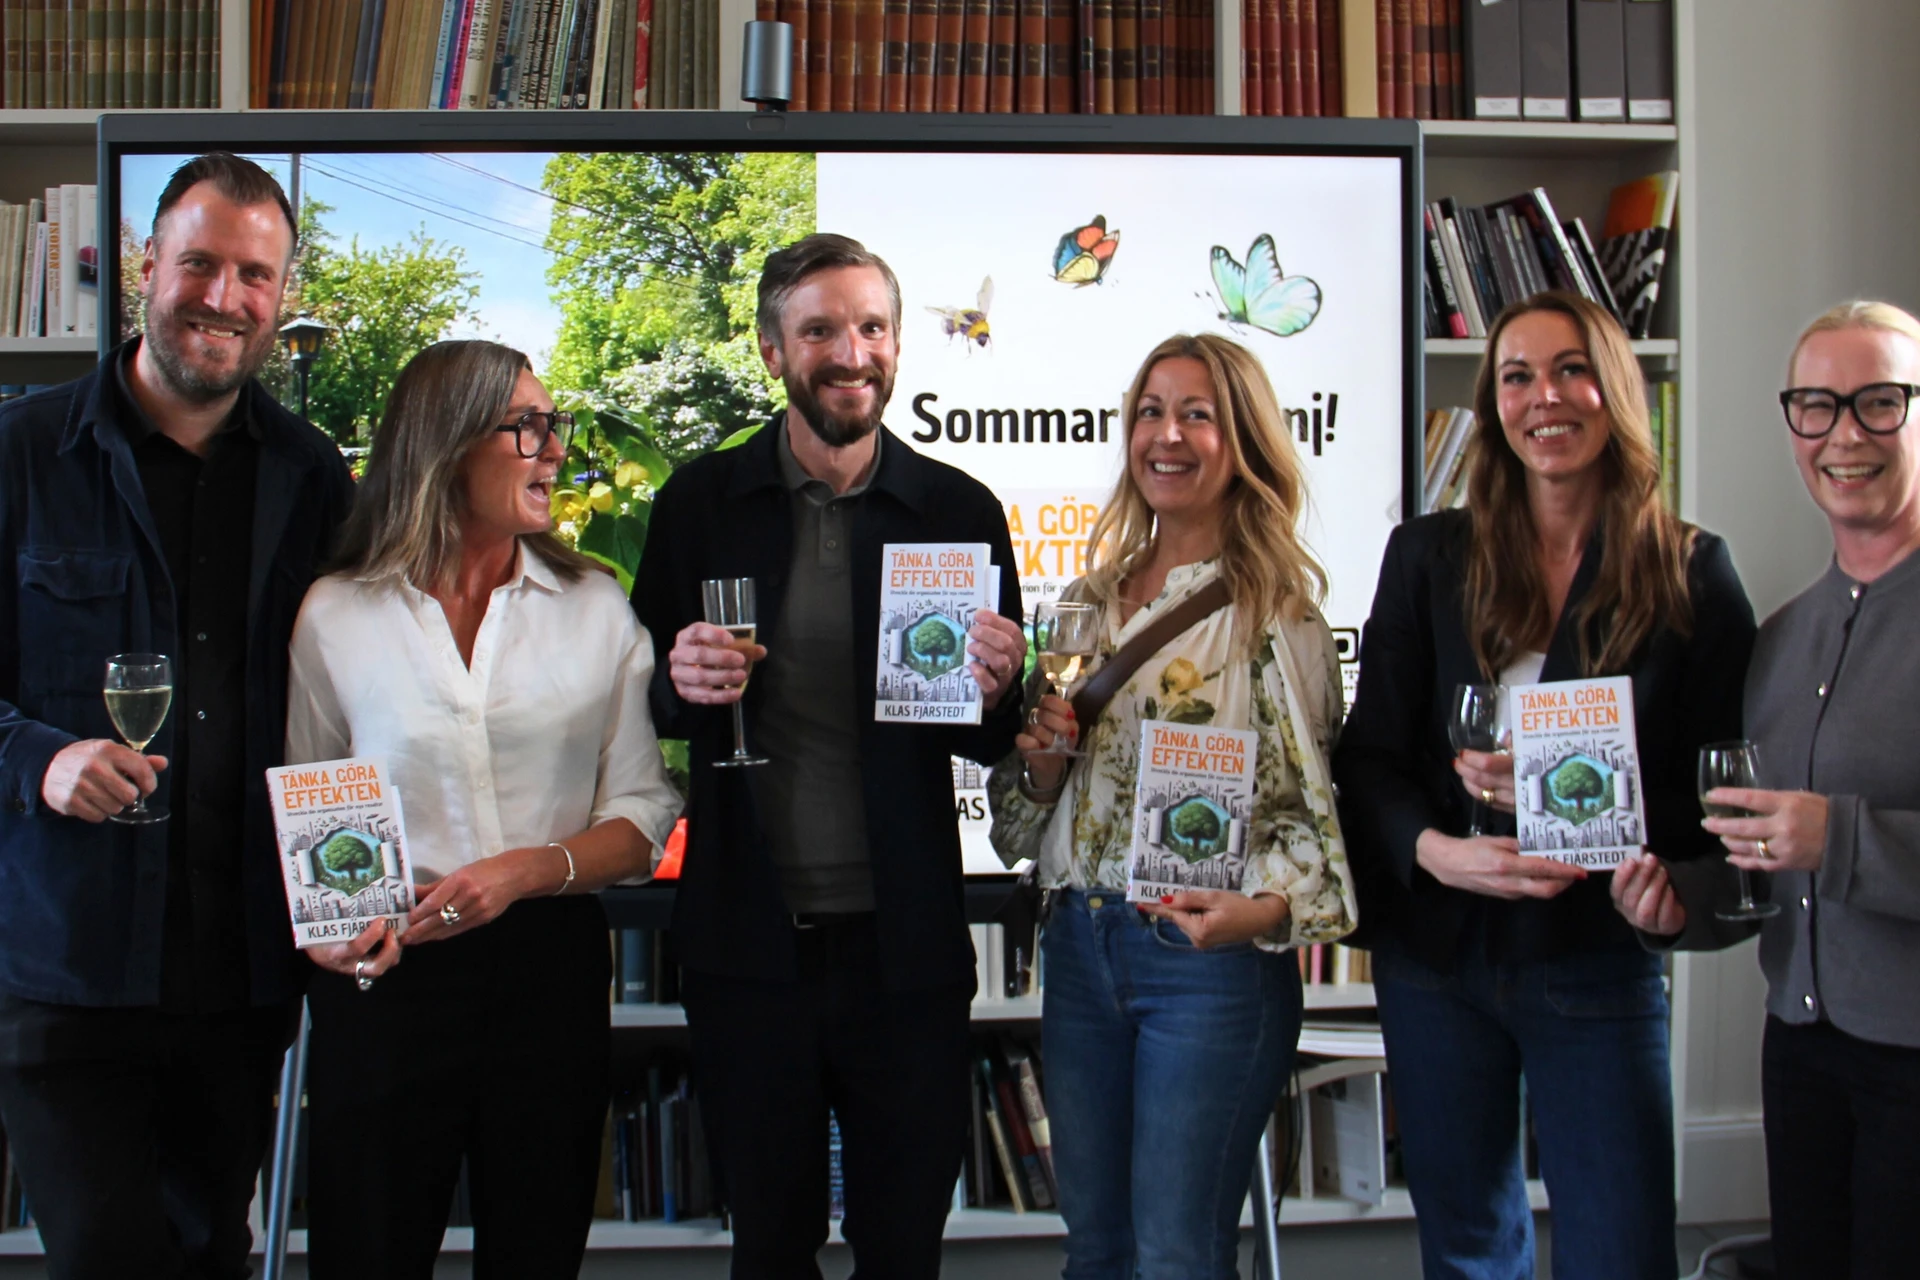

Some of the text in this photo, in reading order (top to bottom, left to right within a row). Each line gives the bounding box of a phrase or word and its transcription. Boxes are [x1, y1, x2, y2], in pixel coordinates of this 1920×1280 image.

[49, 222, 60, 269] ISOKON
[1038, 496, 1100, 535] GÖR
[891, 549, 974, 568] TÄNKA GÖRA
[891, 570, 974, 588] EFFEKTEN
[884, 702, 966, 719] KLAS FJÄRSTEDT
[1520, 685, 1617, 710] TÄNKA GÖRA
[1521, 706, 1619, 731] EFFEKTEN
[1153, 726, 1245, 754] TÄNKA GÖRA
[1151, 747, 1245, 774] EFFEKTEN
[280, 763, 378, 790] TÄNKA GÖRA
[284, 782, 382, 809] EFFEKTEN
[307, 924, 338, 939] KLAS
